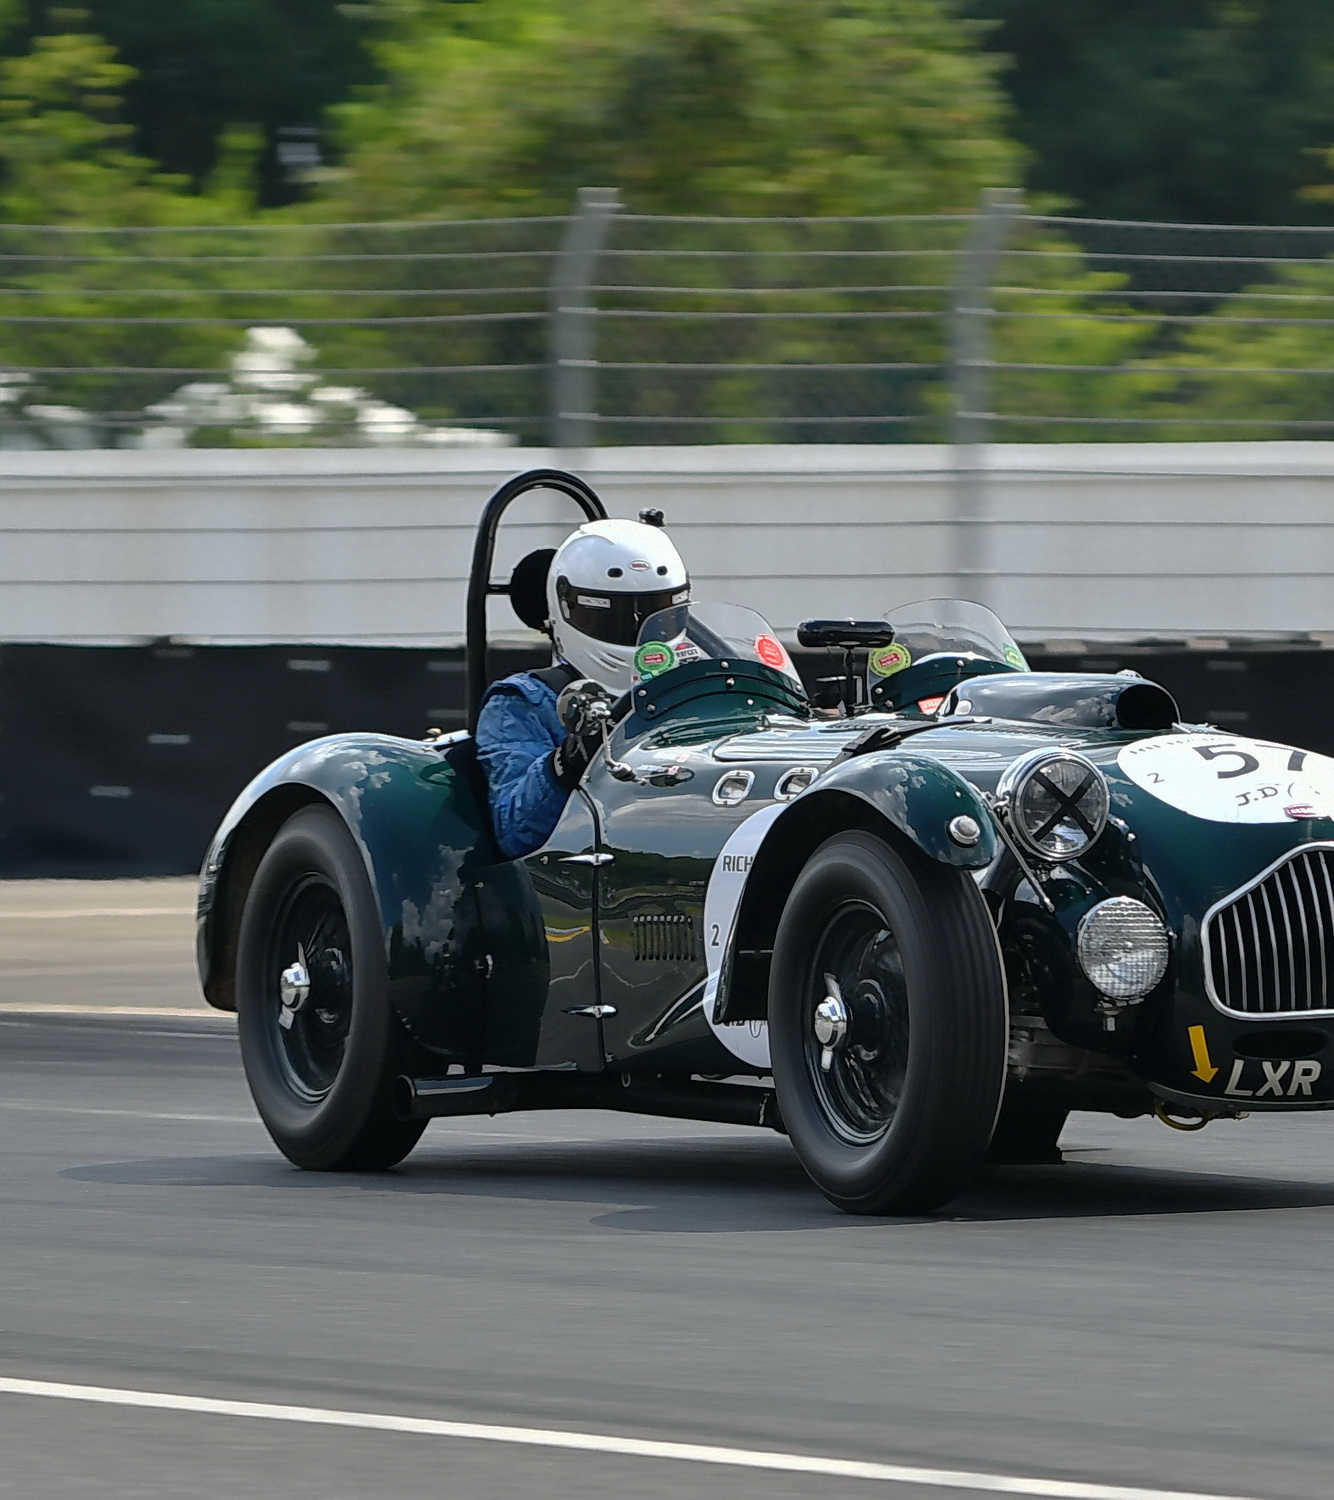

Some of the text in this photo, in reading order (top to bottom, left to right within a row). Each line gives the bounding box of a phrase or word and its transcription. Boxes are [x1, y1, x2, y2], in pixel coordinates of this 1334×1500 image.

[1192, 743, 1308, 780] 57
[1147, 772, 1166, 784] 2
[711, 924, 720, 947] 2
[1224, 1059, 1322, 1097] LXR
